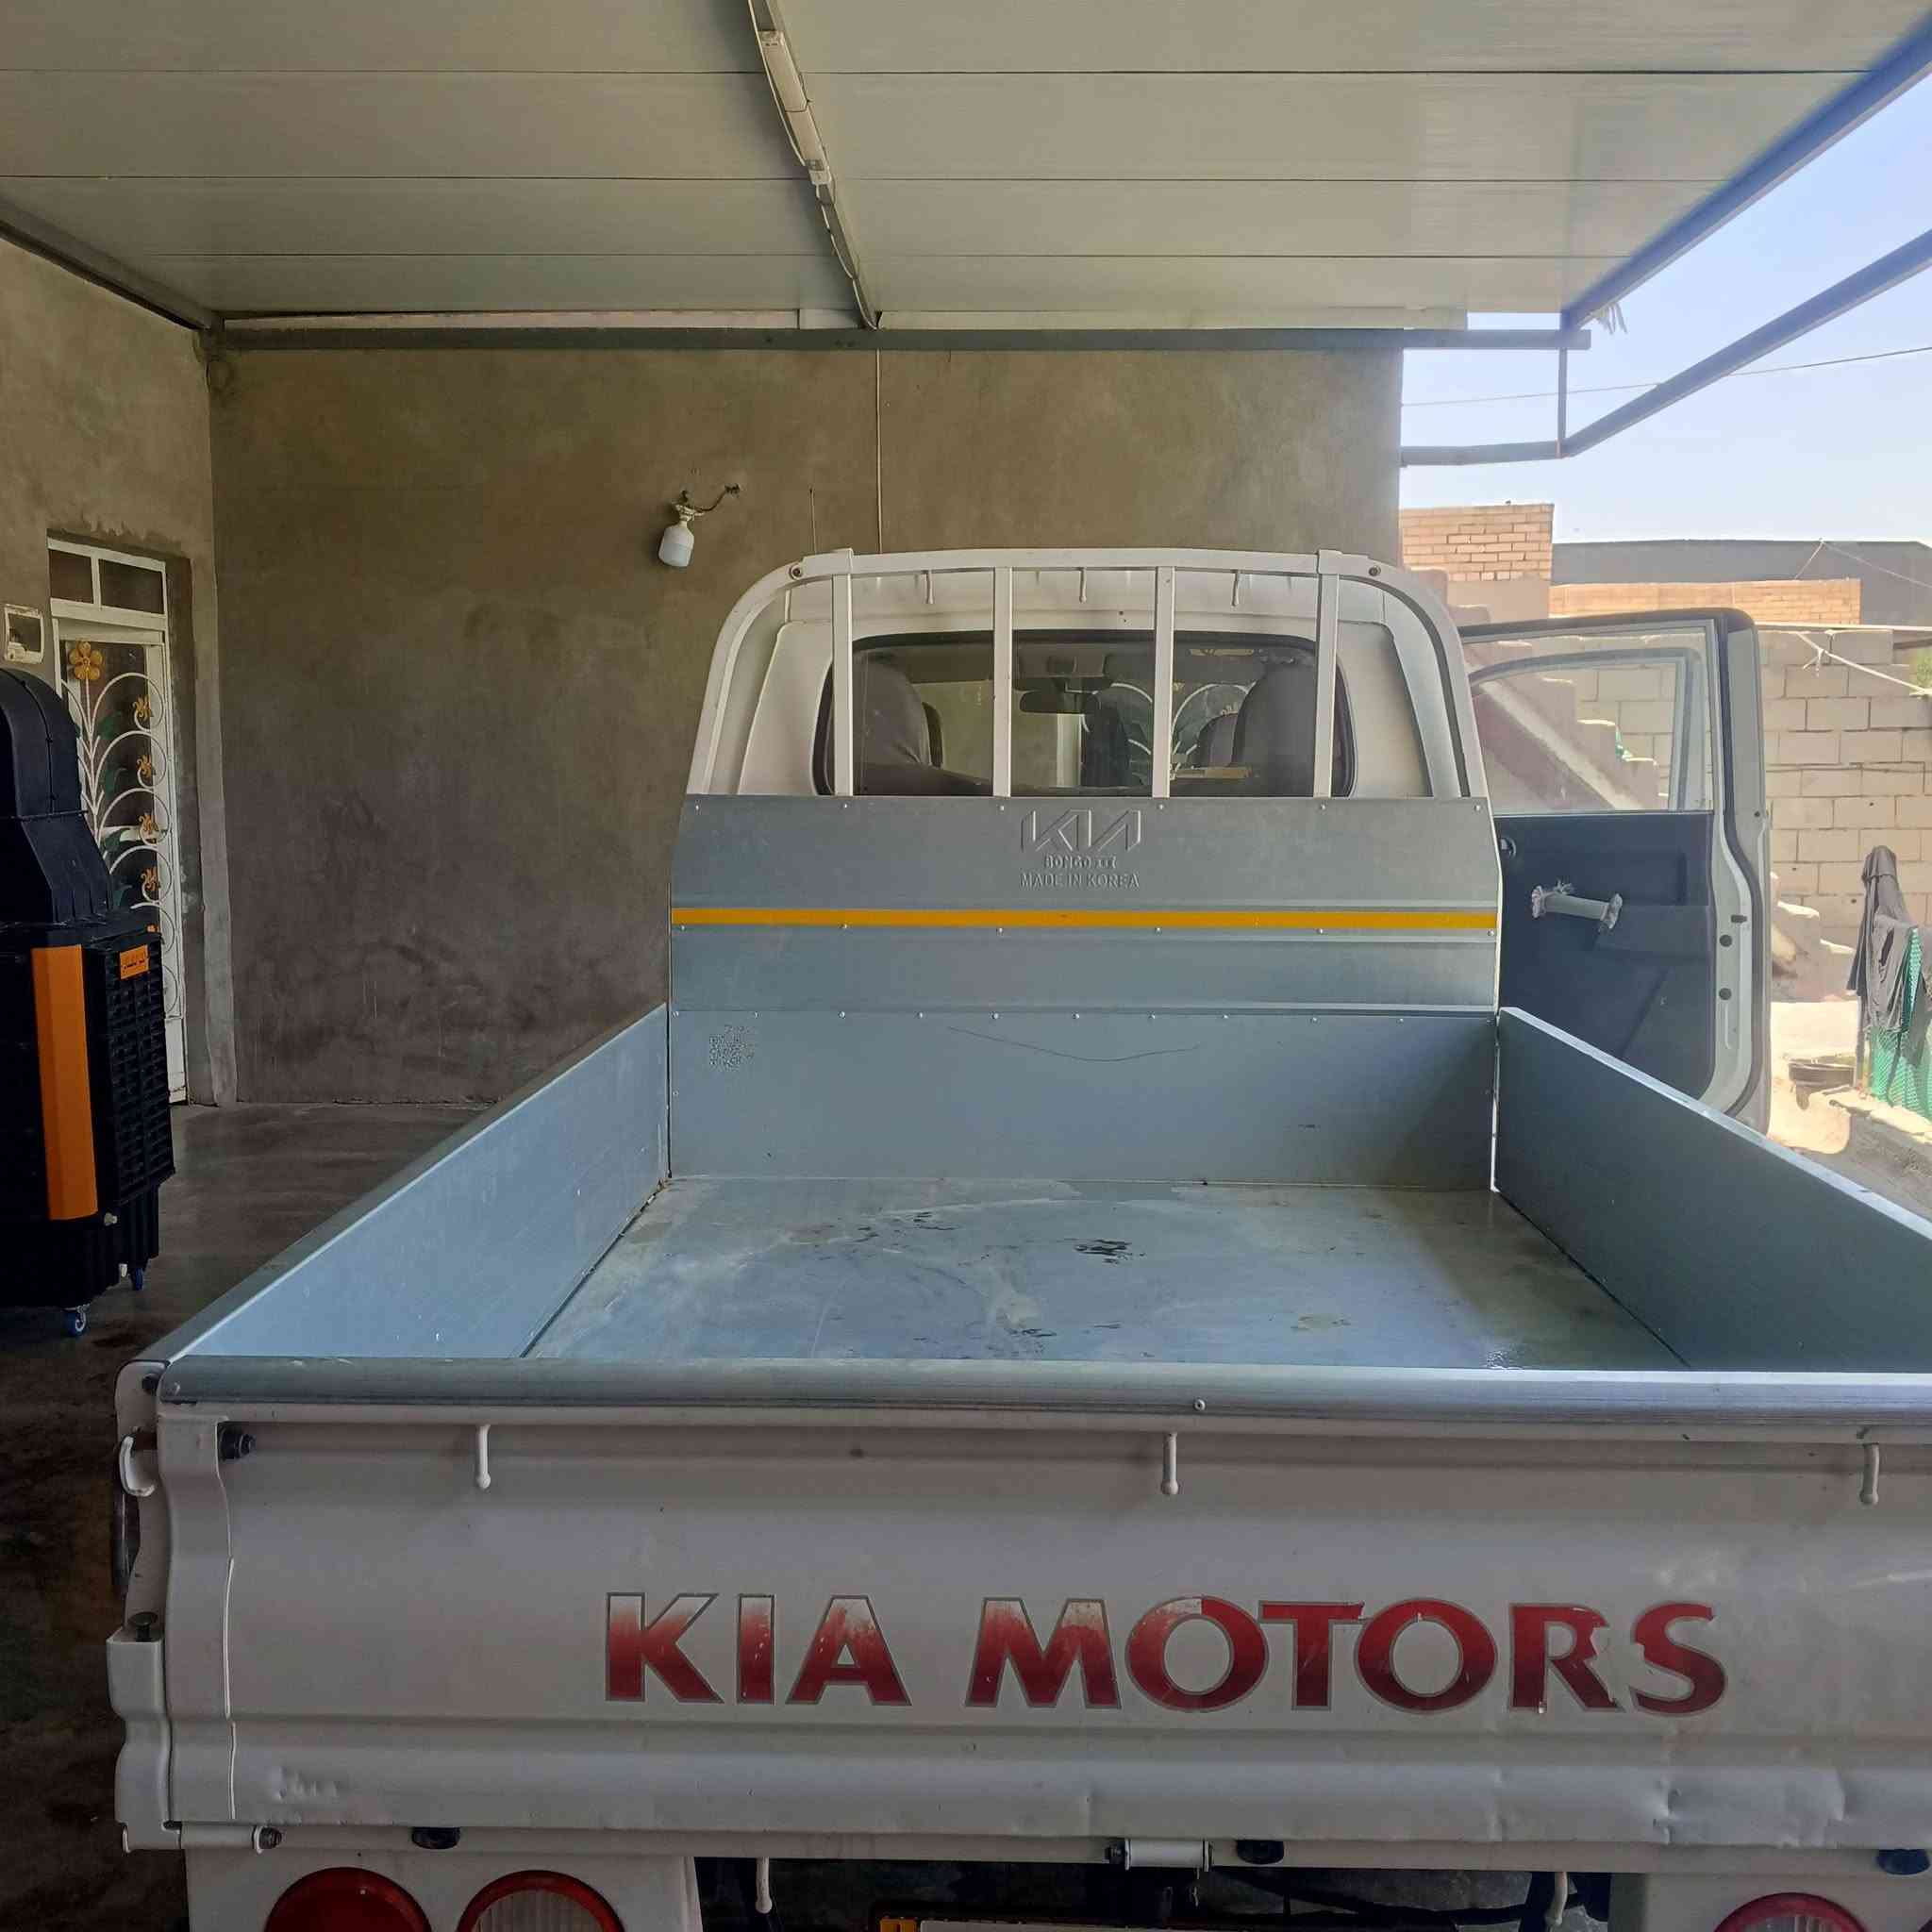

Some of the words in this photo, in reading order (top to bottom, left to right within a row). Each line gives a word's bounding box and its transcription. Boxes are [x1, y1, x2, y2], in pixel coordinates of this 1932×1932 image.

[1020, 872, 1062, 888] MADE
[1067, 872, 1082, 888] IN
[1087, 872, 1141, 888] KOREA
[604, 1591, 912, 1707] KIA
[962, 1594, 1729, 1716] MOTORS
